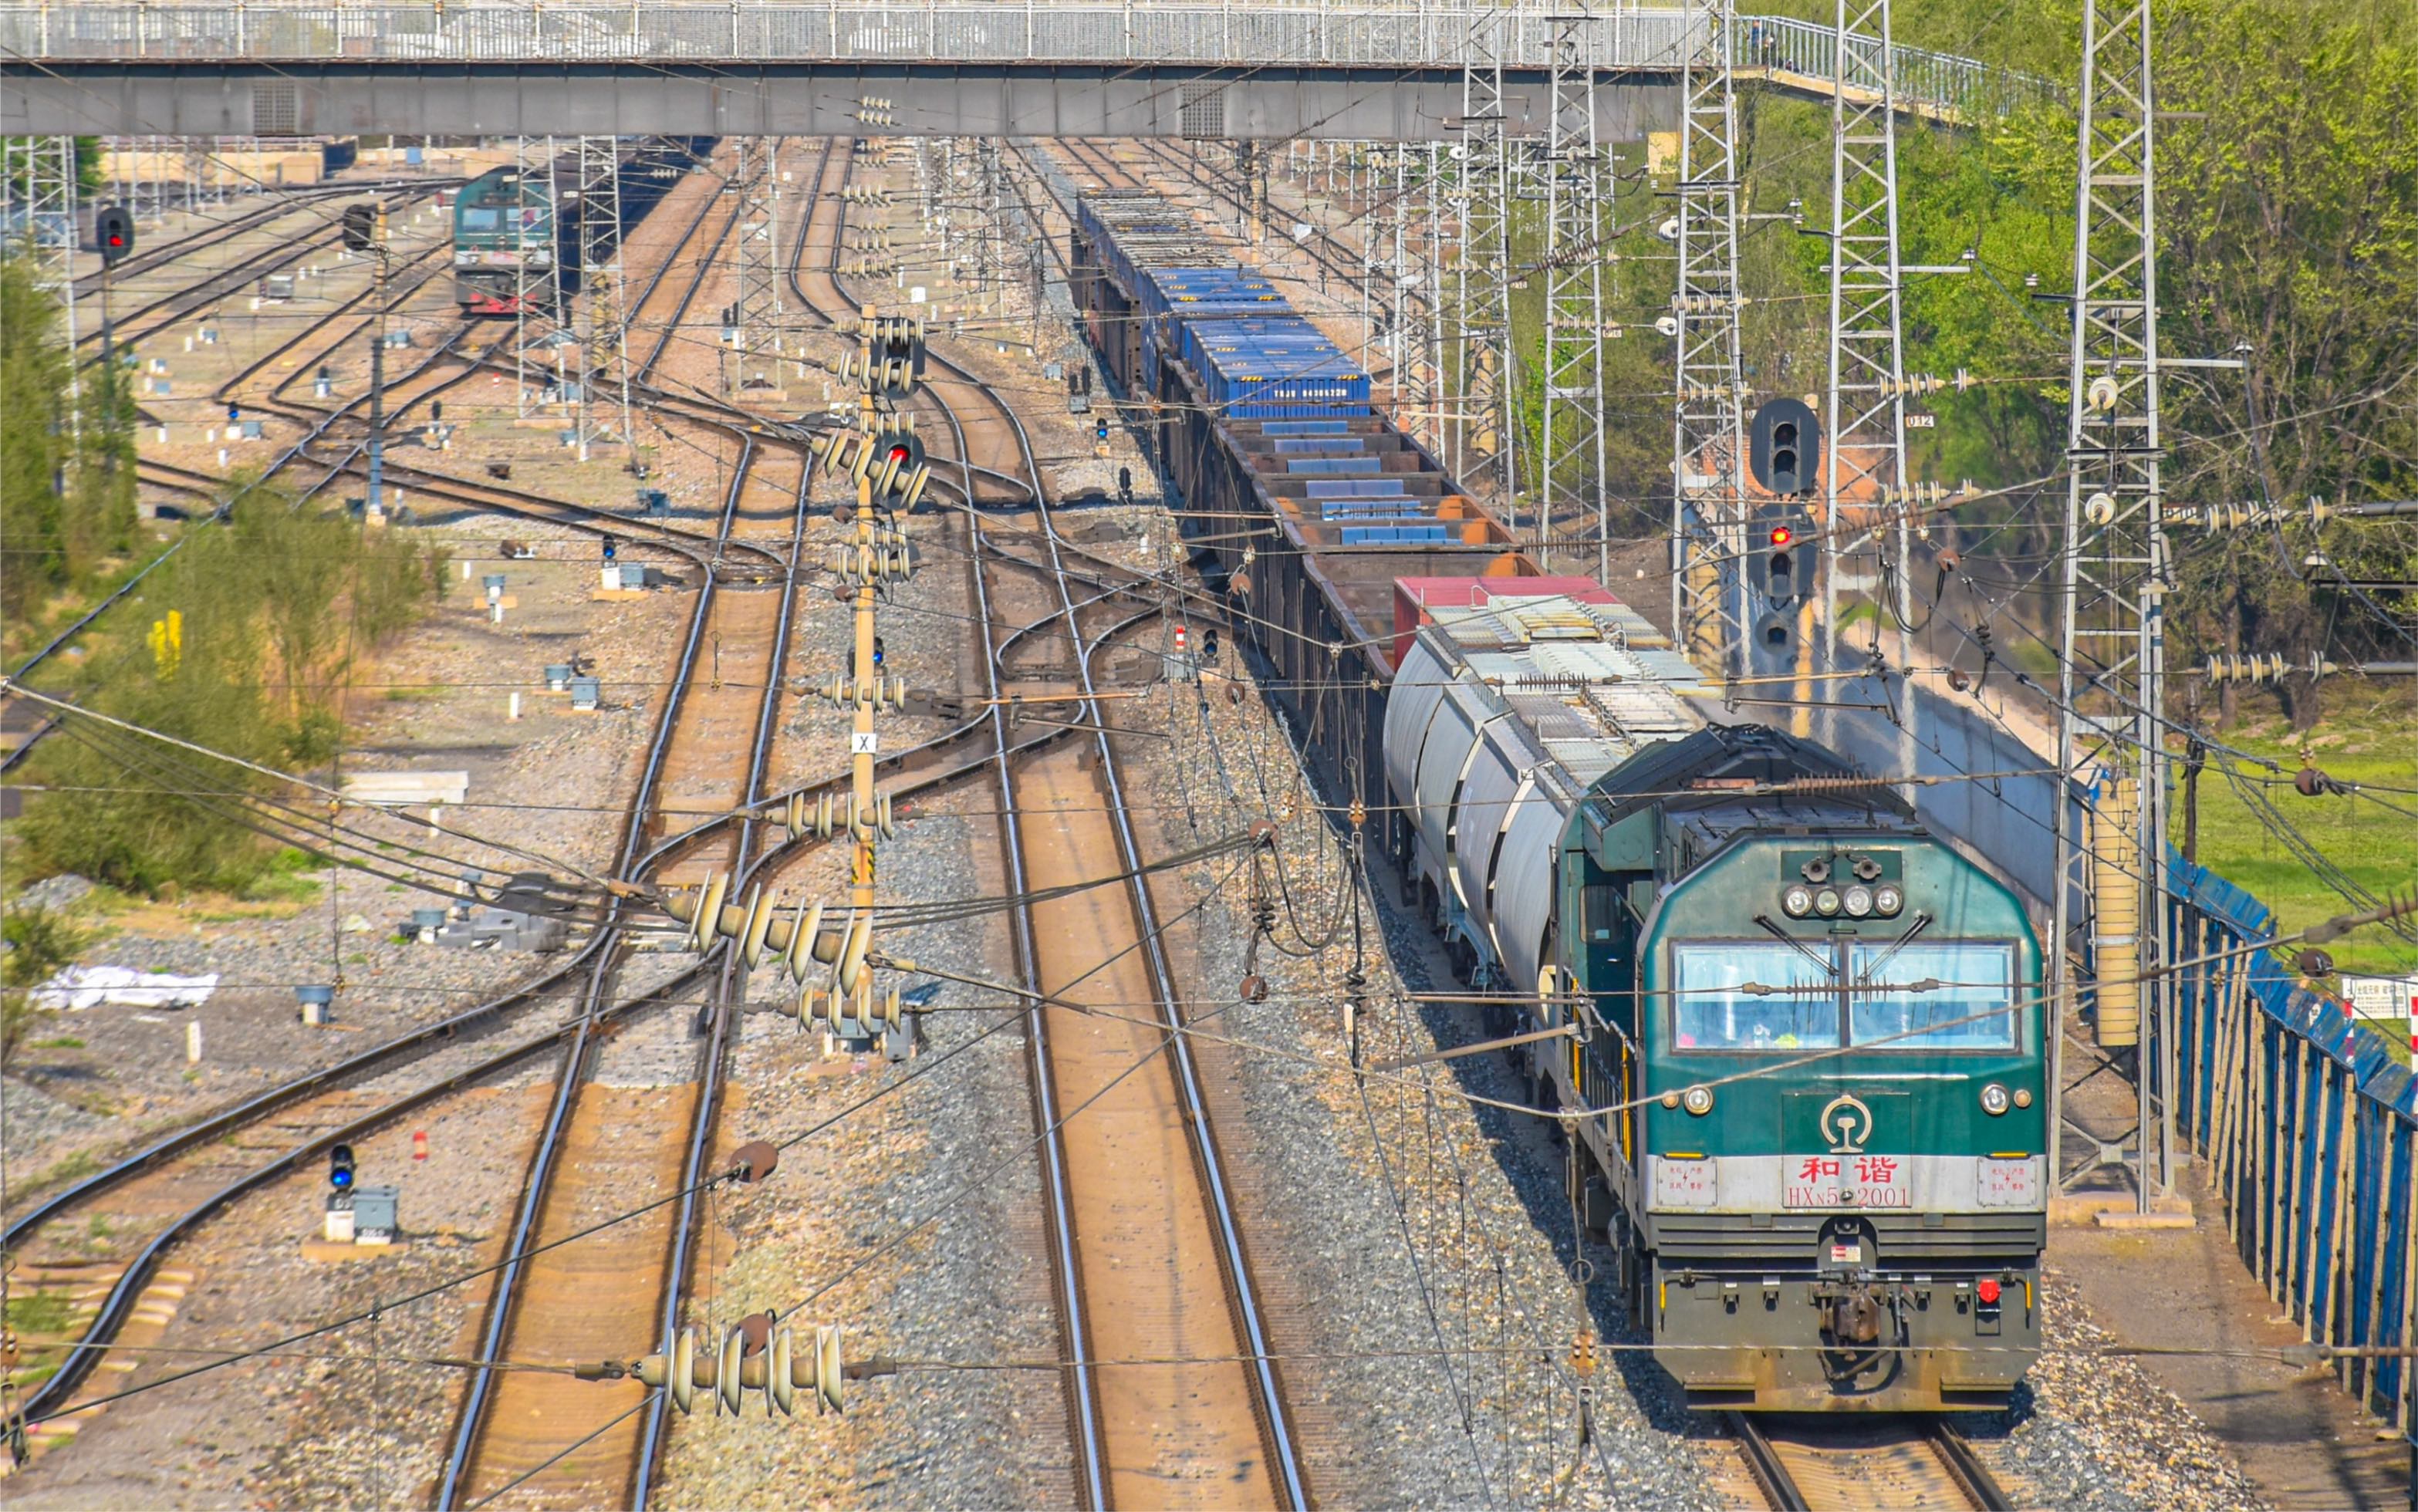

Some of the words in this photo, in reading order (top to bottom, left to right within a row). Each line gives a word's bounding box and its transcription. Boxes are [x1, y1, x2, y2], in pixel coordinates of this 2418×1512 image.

[1907, 415, 1932, 427] 012
[859, 735, 869, 751] X
[1799, 1157, 1898, 1183] 和谐
[1858, 1188, 1907, 1206] 2001
